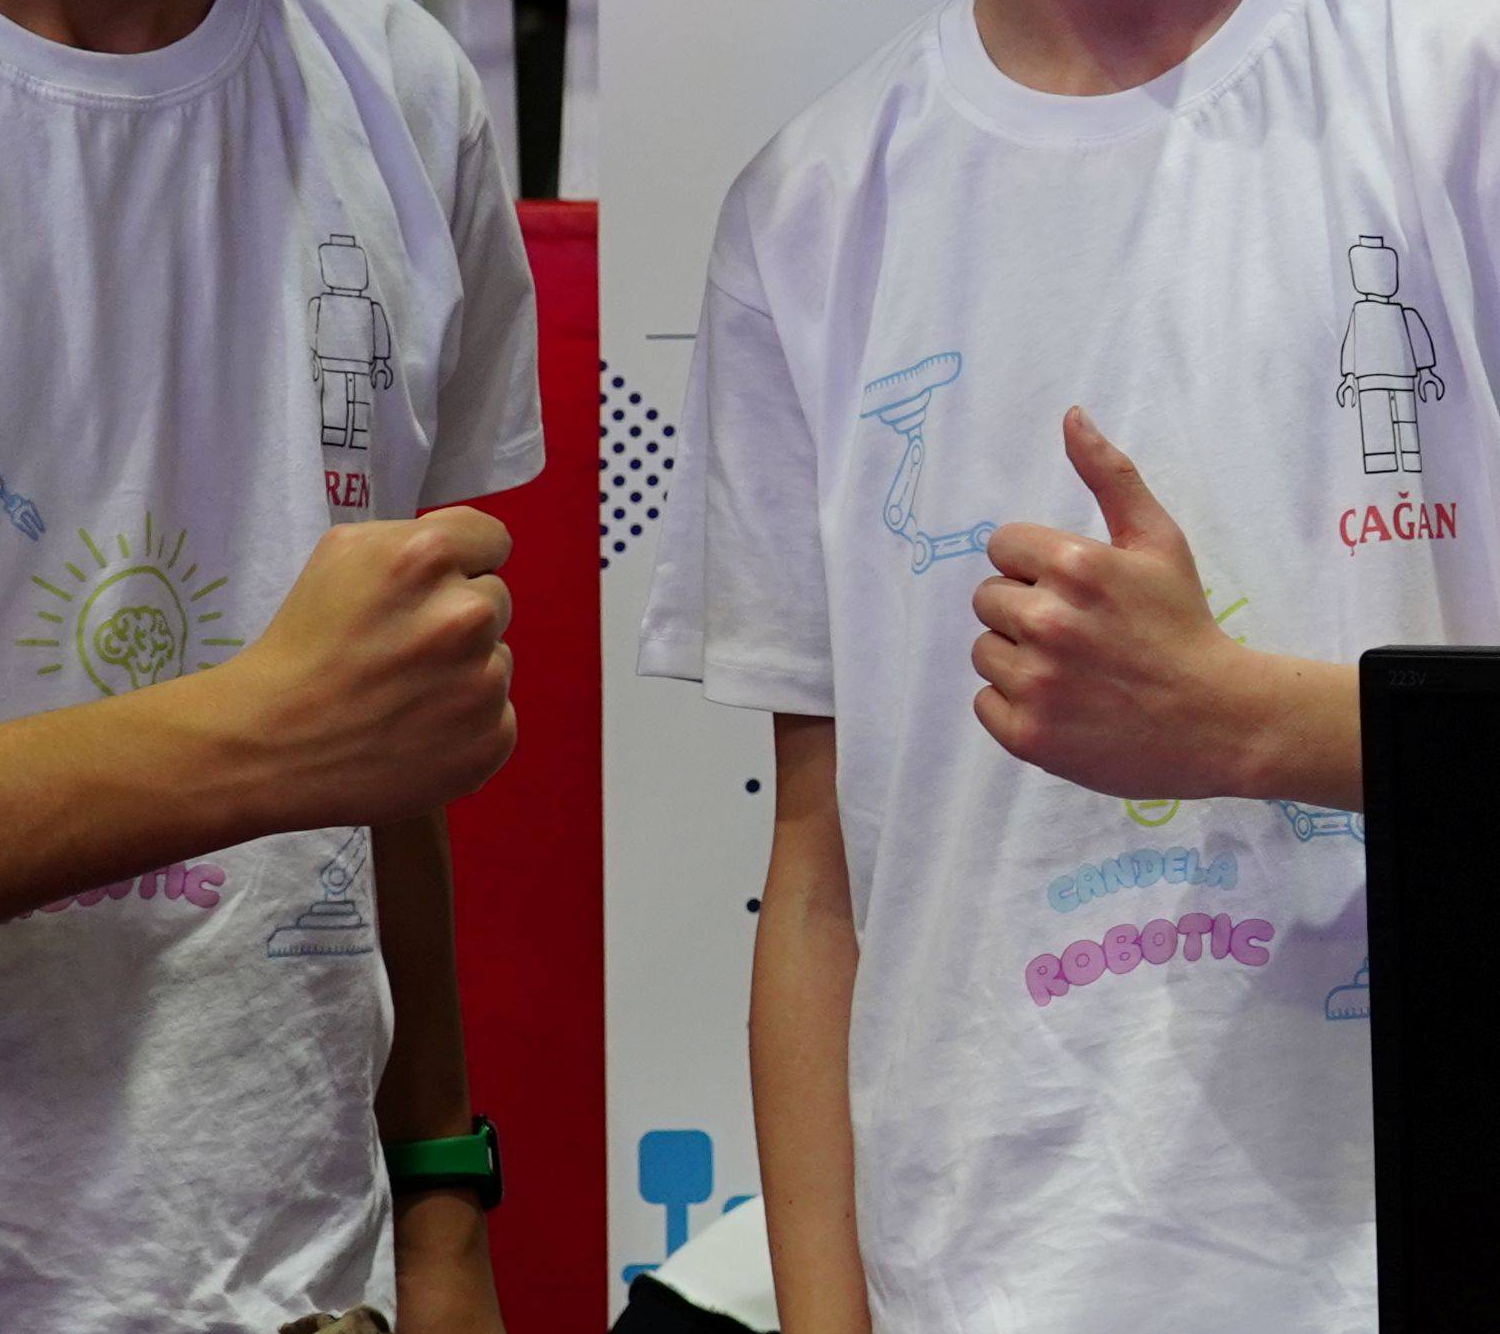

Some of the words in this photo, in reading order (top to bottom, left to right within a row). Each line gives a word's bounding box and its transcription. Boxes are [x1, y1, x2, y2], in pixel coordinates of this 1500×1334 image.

[324, 469, 371, 509] REN
[1338, 490, 1458, 557] ÇAĞAN
[1046, 845, 1239, 913] CANDELA
[1025, 912, 1276, 1007] ROBOTIC
